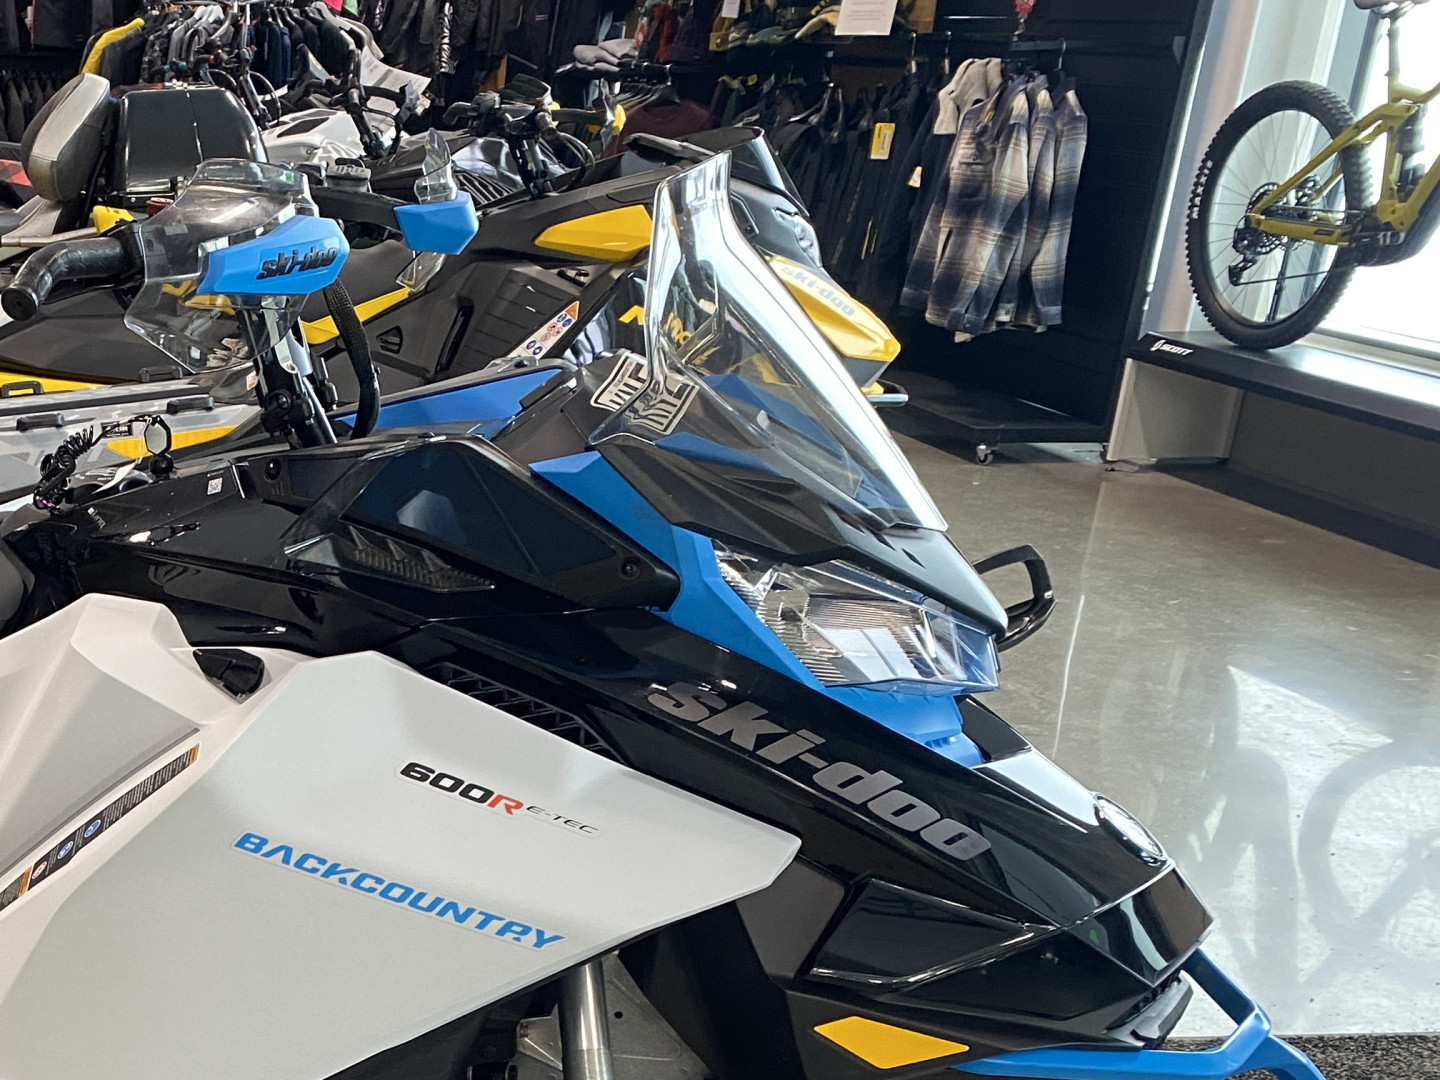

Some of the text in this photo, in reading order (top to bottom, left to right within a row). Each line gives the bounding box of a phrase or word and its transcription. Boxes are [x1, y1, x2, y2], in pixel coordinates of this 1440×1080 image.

[399, 761, 599, 834] 600R E-TEC
[647, 681, 992, 862] ski-doo
[233, 832, 566, 950] BACKCOUNTRY
